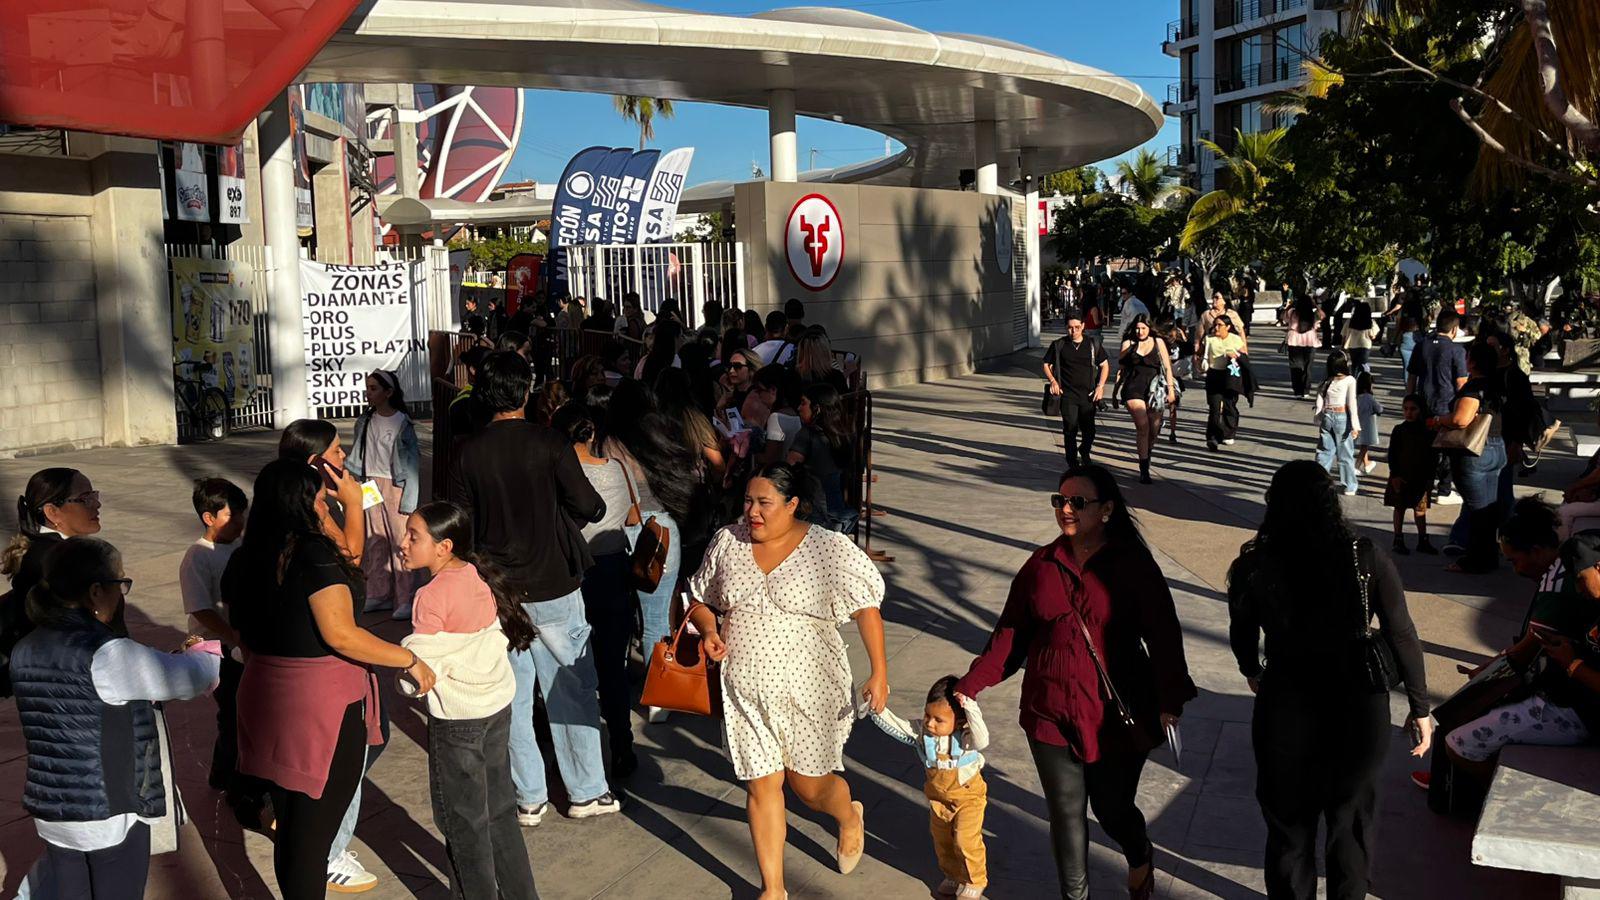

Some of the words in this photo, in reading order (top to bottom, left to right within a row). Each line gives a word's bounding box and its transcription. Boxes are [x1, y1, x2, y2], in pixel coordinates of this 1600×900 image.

[227, 186, 242, 203] exa
[331, 273, 403, 291] ZONAS
[303, 310, 349, 325] -ORO
[303, 326, 355, 340] -PLUS
[304, 341, 356, 356] -PLUS
[361, 338, 430, 355] PLATIN
[305, 357, 345, 372] -SKY
[306, 373, 347, 388] -SKY
